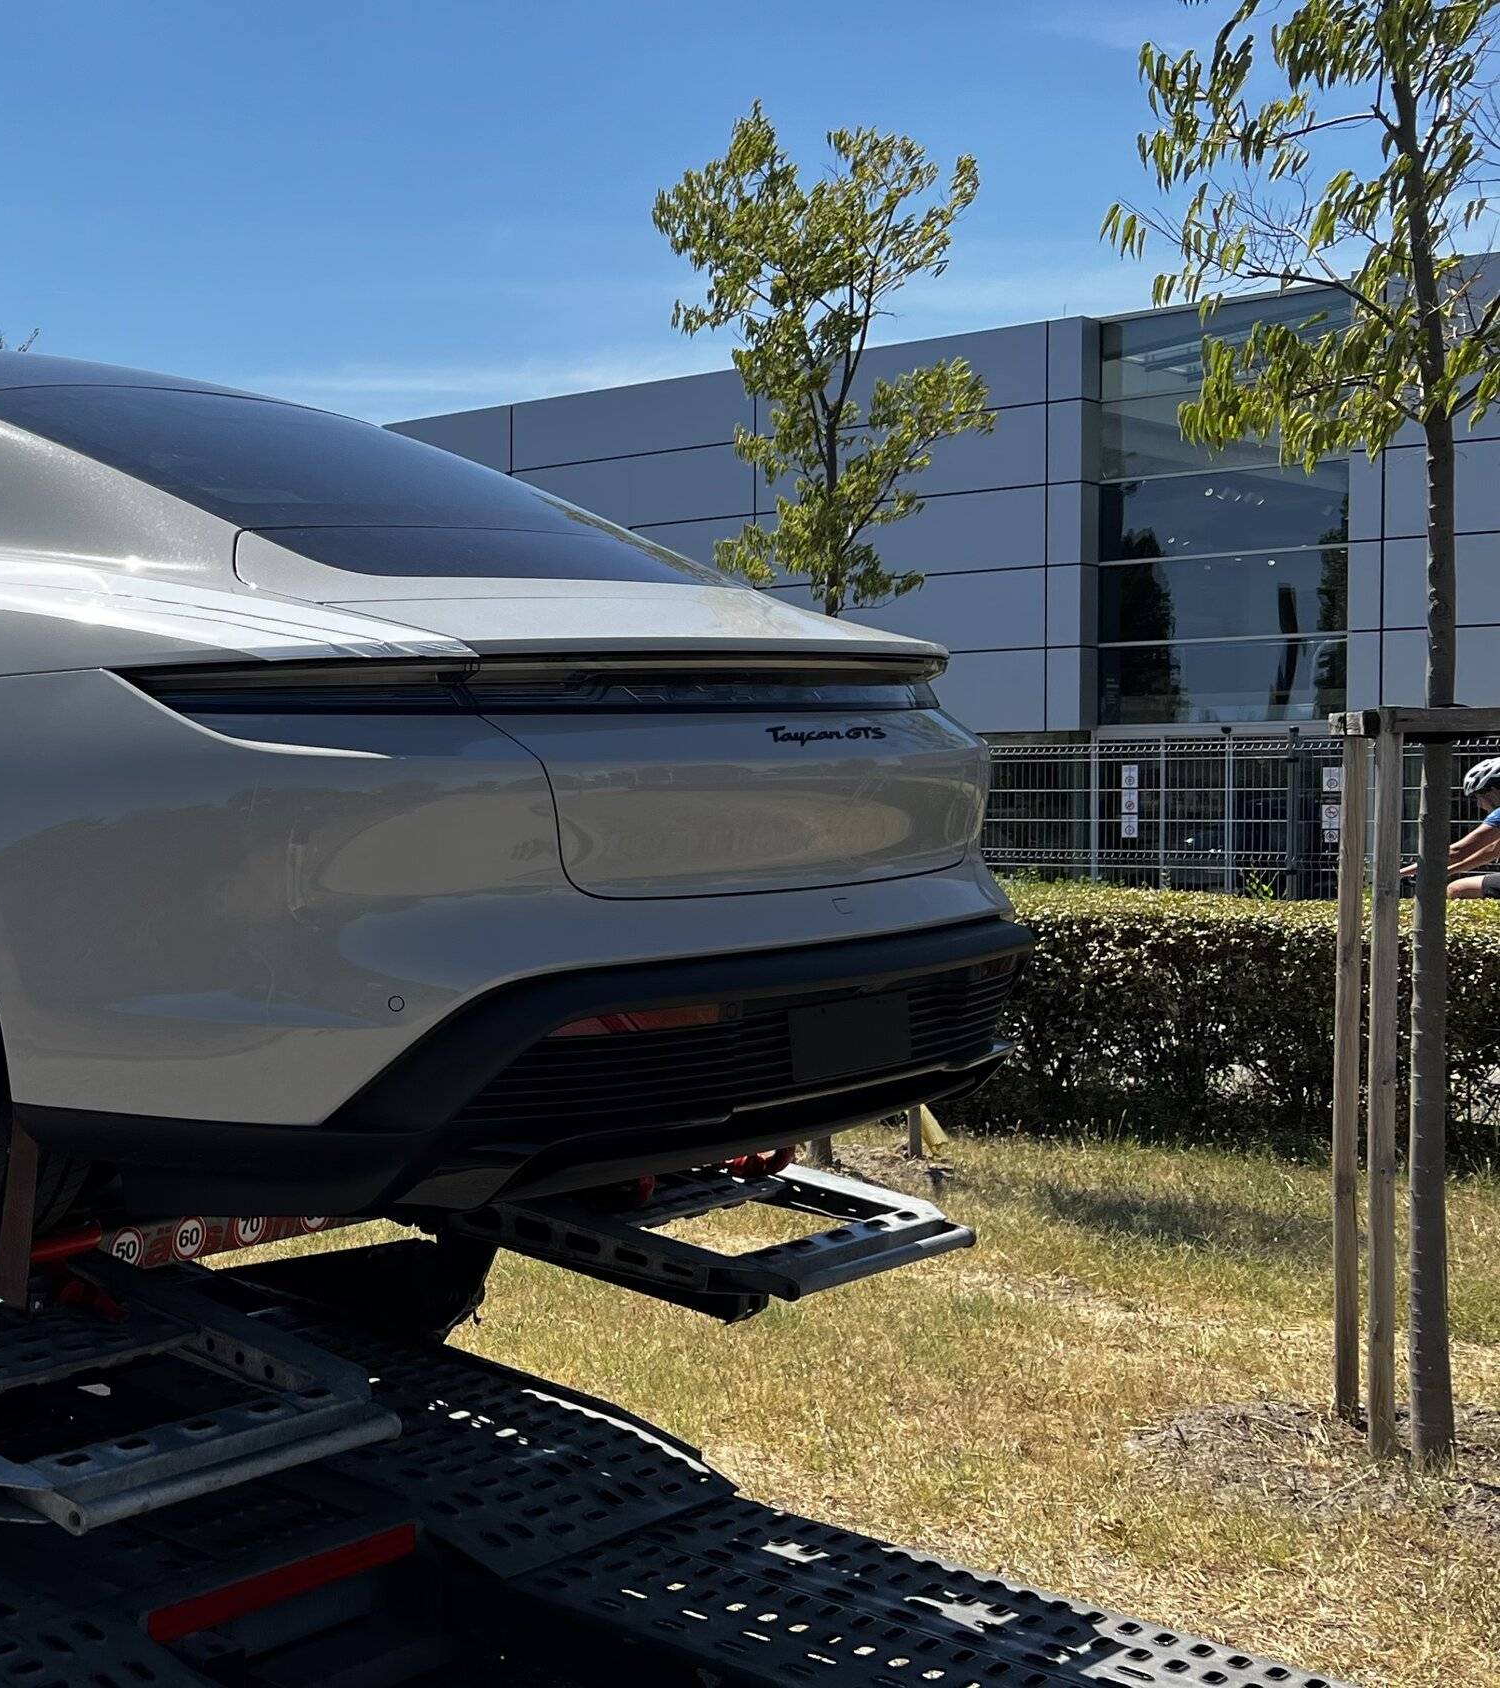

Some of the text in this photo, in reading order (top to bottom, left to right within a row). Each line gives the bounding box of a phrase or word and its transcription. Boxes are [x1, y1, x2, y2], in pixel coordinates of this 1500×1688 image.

[765, 726, 887, 747] Taycan GTS
[241, 1216, 260, 1235] 70
[178, 1227, 200, 1248] 60
[115, 1240, 137, 1261] 50
